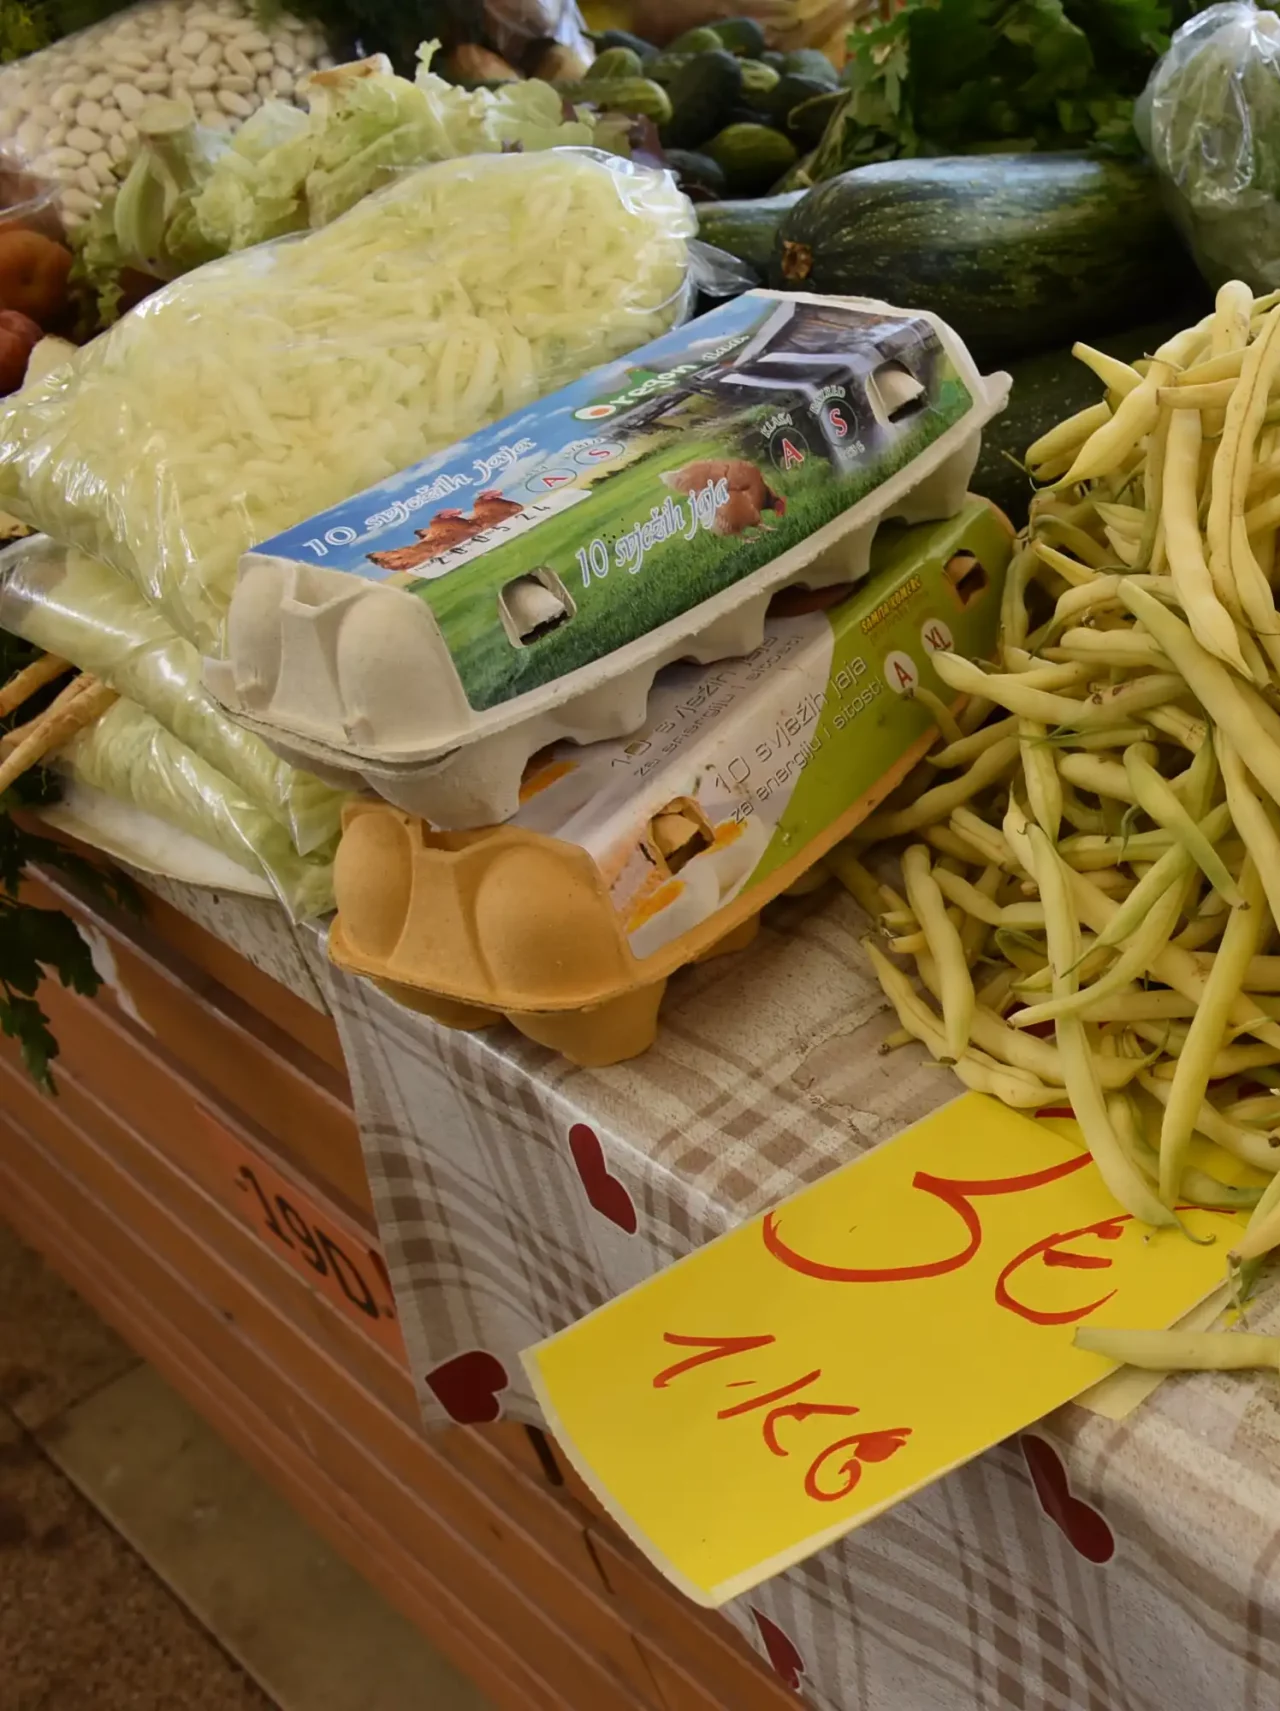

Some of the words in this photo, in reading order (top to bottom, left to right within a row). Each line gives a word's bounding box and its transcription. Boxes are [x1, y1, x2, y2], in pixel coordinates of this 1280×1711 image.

[573, 363, 699, 421] Oregon
[829, 407, 849, 438] S
[587, 447, 612, 460] S
[781, 437, 805, 470] A
[302, 525, 359, 557] 10
[363, 472, 473, 532] svježih
[470, 437, 538, 487] jaja
[540, 475, 570, 488] A
[575, 538, 610, 588] 10
[614, 495, 687, 574] svježih
[683, 477, 731, 541] jaja
[924, 625, 953, 652] XL
[893, 660, 914, 689] A
[714, 755, 752, 794] 10
[754, 689, 830, 762] svježih
[830, 655, 868, 700] jaja
[730, 800, 755, 826] za
[754, 736, 824, 803] energiju
